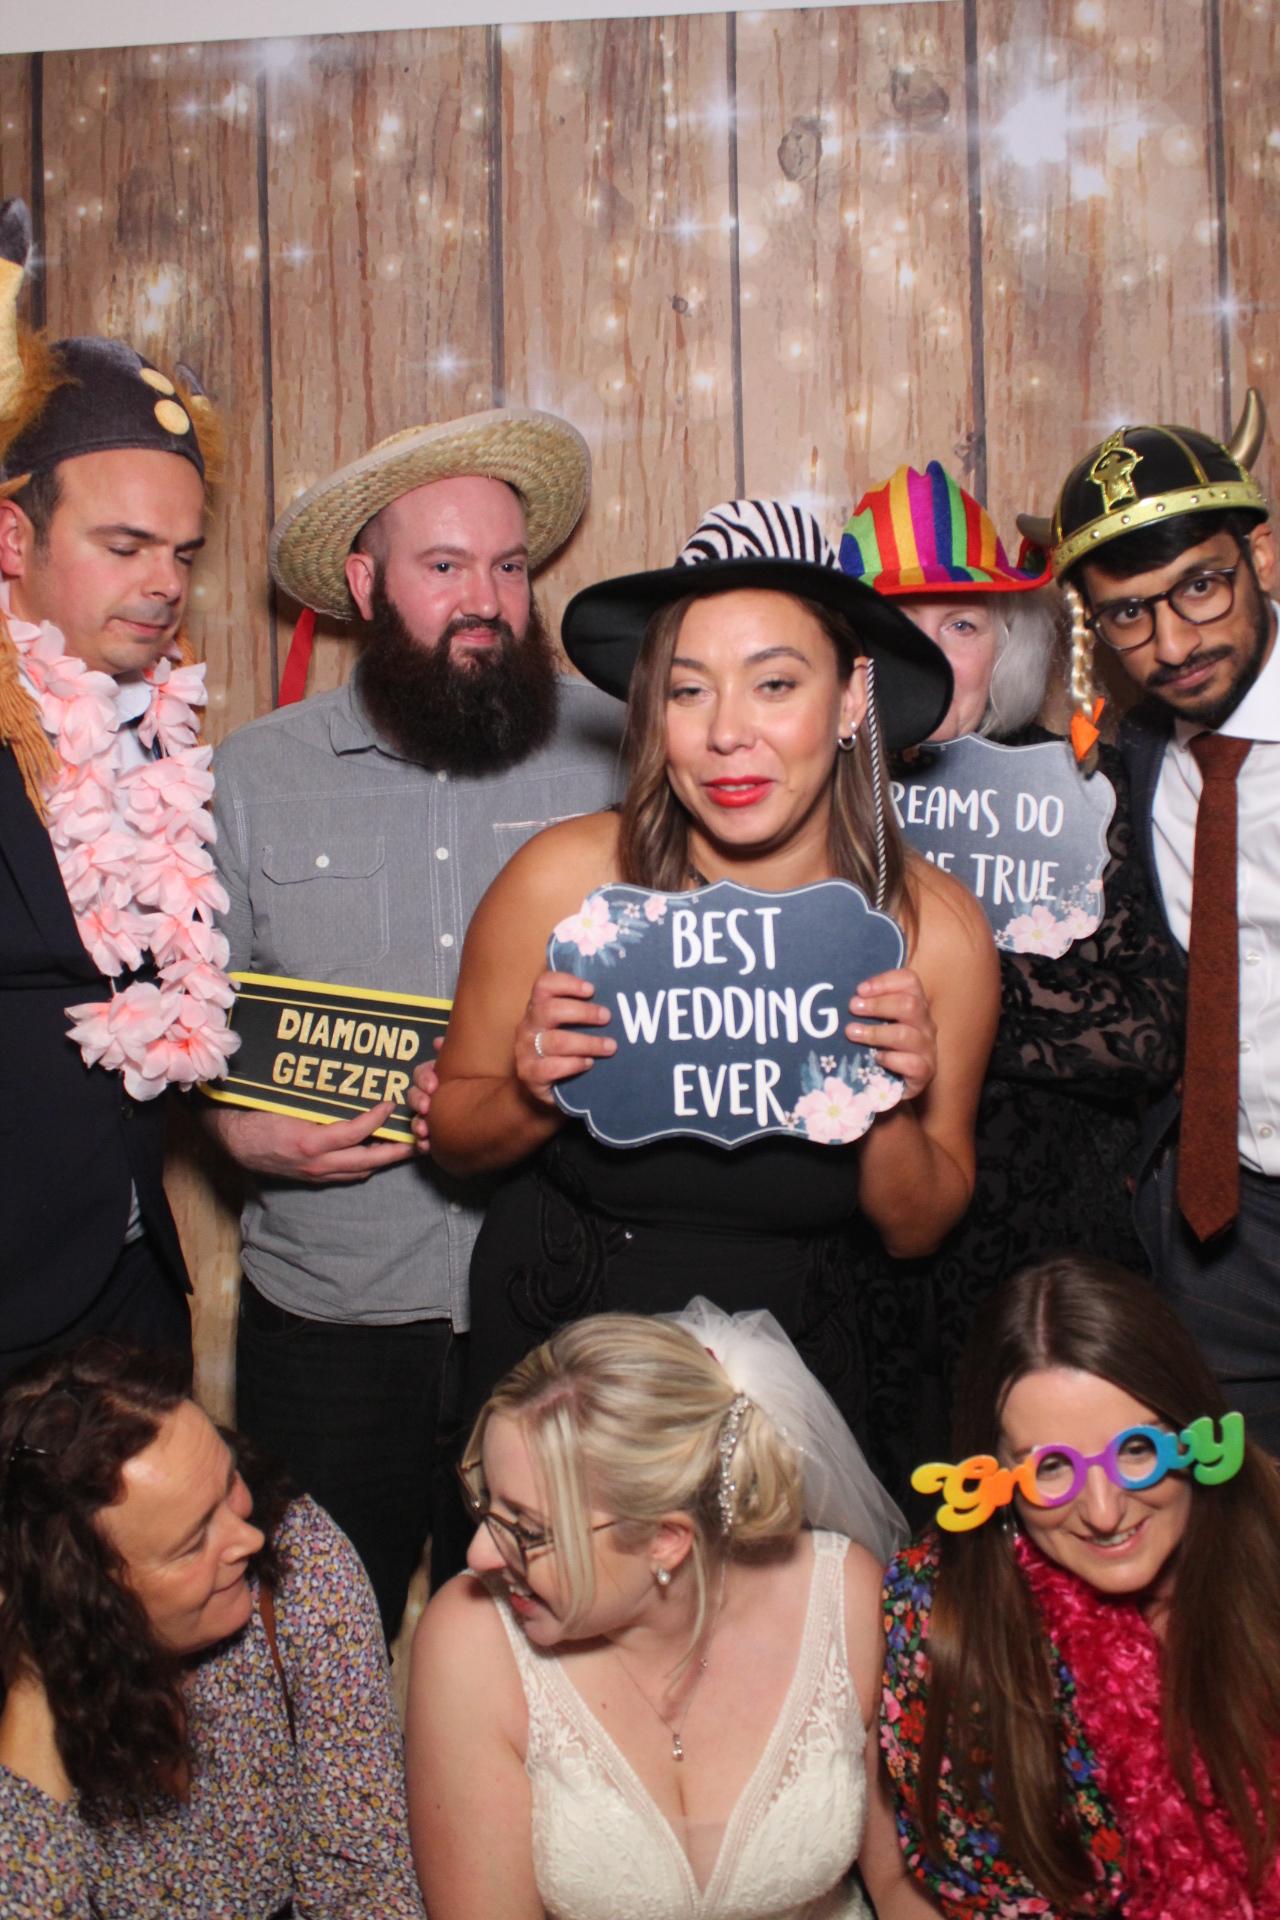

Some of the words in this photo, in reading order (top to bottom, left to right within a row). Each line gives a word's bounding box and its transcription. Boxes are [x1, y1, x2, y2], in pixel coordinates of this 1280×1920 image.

[888, 781, 1000, 838] REAMS
[1016, 792, 1064, 837] DO
[970, 853, 1060, 905] TRUE
[672, 907, 782, 975] BEST
[277, 1008, 420, 1062] DIAMOND
[616, 983, 839, 1045] WEDDING
[272, 1052, 410, 1105] GEEZER
[673, 1059, 784, 1127] EVER
